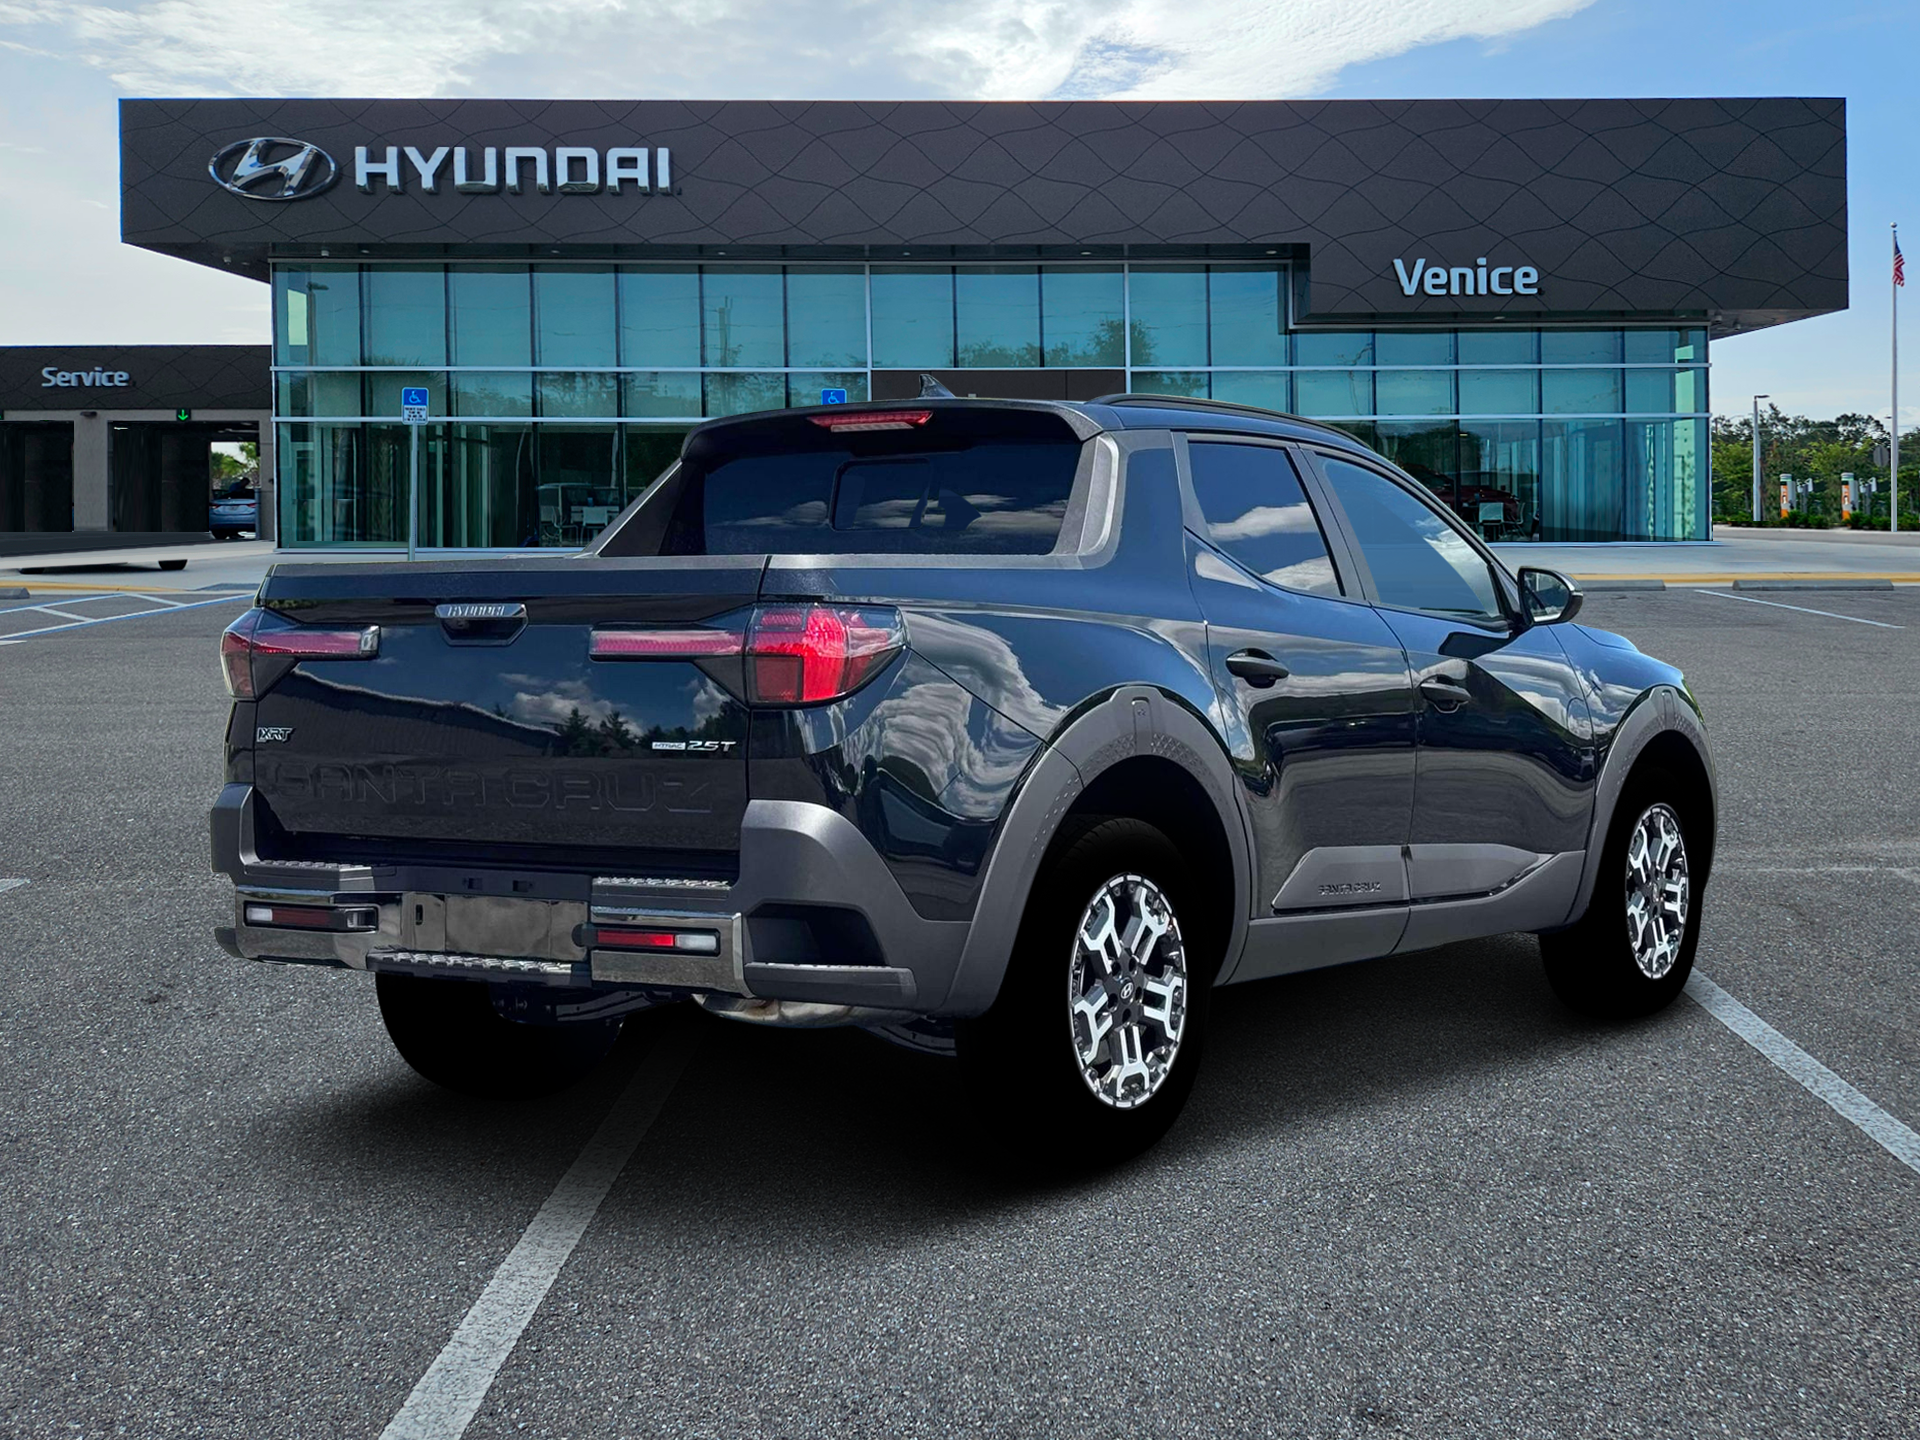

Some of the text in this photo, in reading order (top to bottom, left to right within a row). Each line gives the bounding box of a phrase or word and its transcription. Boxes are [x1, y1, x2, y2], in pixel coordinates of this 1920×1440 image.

[354, 146, 670, 195] HYUNDAI
[1392, 257, 1539, 296] Venice
[41, 366, 129, 387] Service
[257, 727, 293, 742] XRT
[272, 760, 713, 814] SANTA CRUZ
[1318, 881, 1382, 896] SANTA CRUZ
